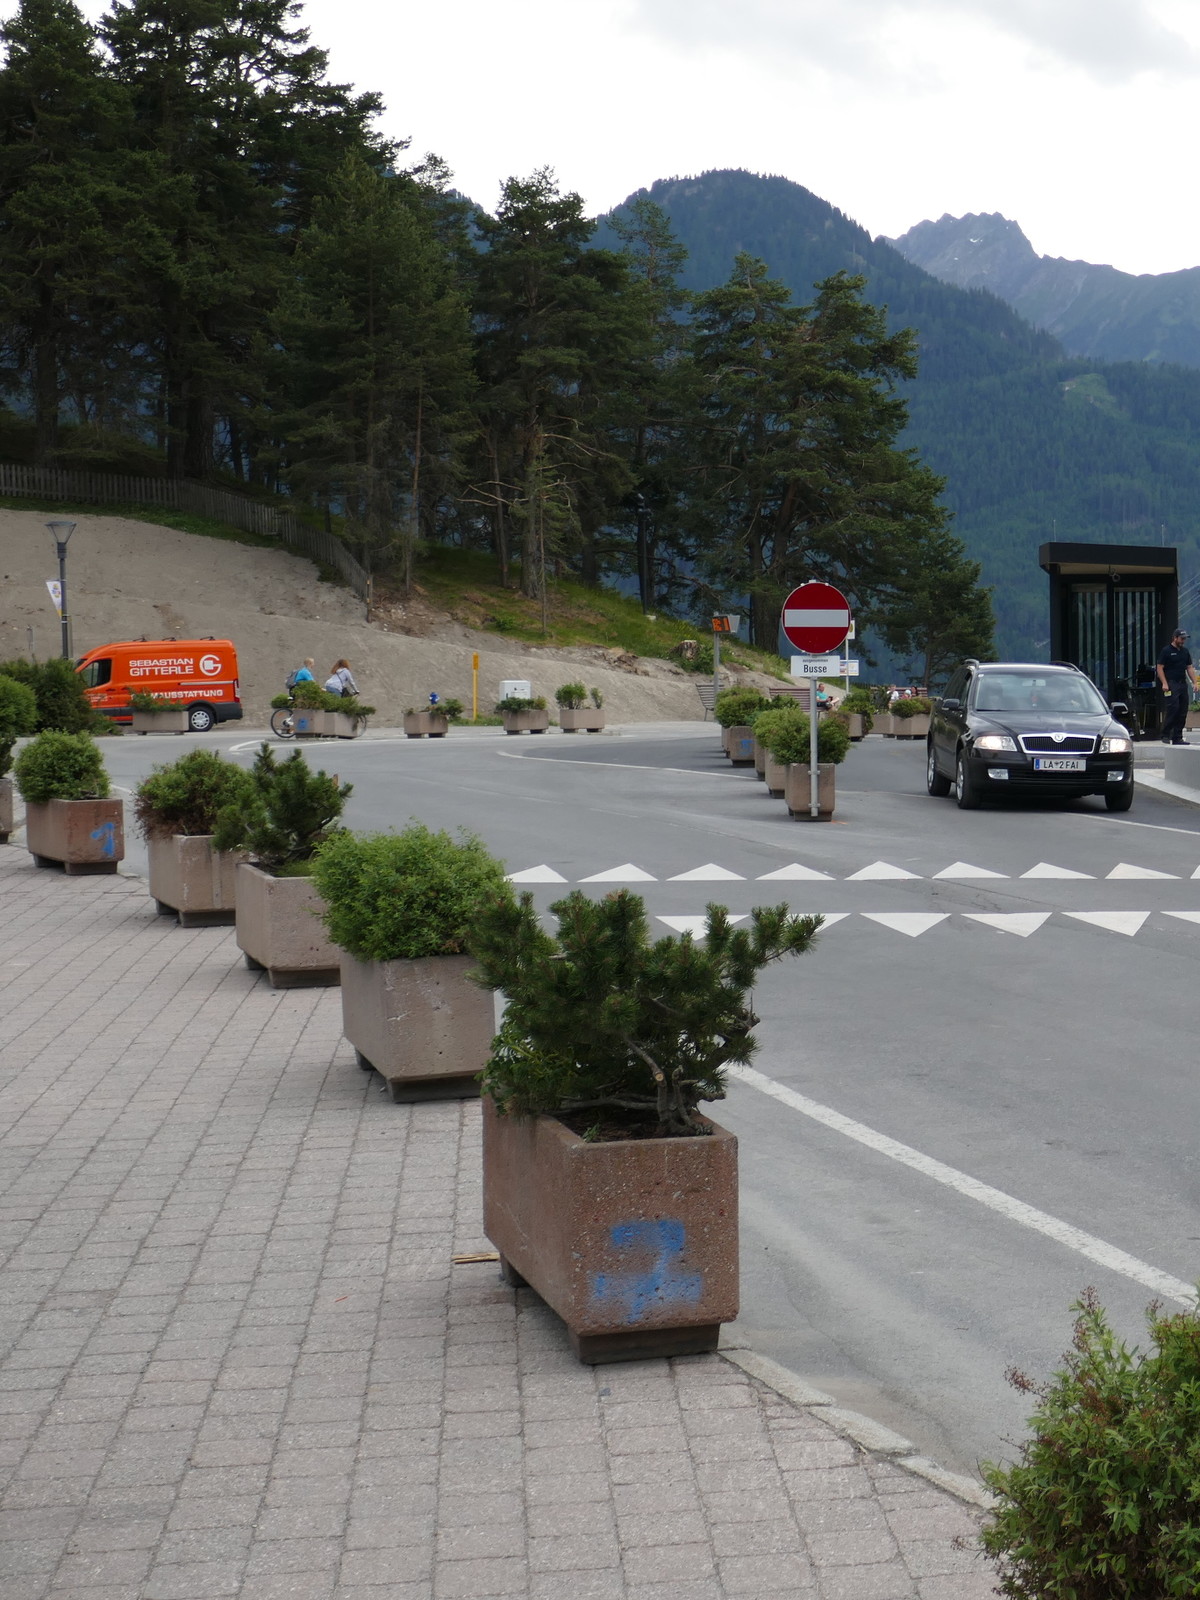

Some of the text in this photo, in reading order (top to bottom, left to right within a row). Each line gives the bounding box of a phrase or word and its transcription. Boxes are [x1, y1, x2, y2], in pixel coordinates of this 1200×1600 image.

[129, 658, 193, 667] SEBASTIAN
[129, 666, 194, 676] GITTERLE
[803, 664, 827, 673] Busse
[1043, 760, 1054, 769] LA
